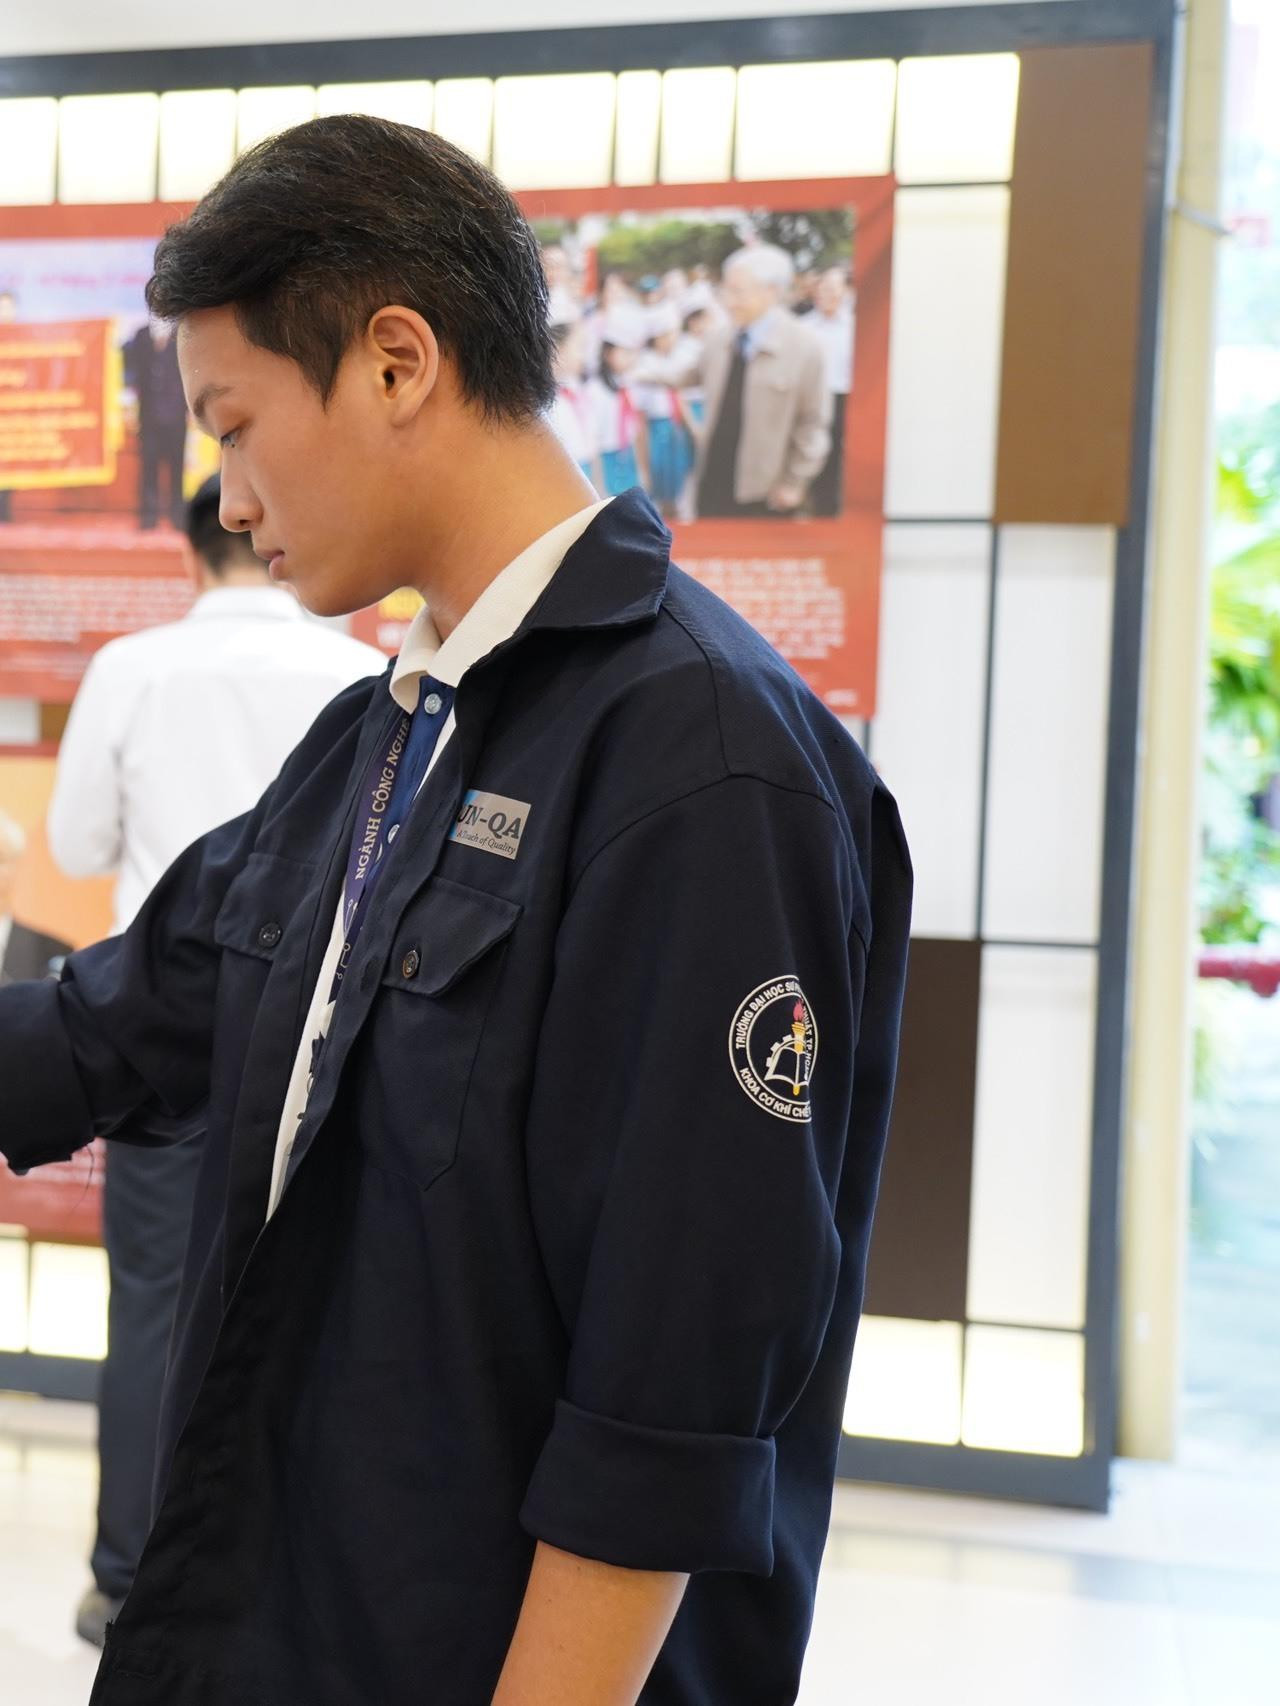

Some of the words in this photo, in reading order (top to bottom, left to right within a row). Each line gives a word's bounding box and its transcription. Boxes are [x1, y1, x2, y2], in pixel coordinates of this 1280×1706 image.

[355, 818, 381, 881] NGÀNH
[371, 767, 395, 812] CÔNG
[735, 1010, 754, 1050] TRƯỜNG
[749, 995, 766, 1013] ĐẠI
[765, 983, 786, 999] HỌC
[739, 1067, 759, 1096] KHOA
[758, 1091, 775, 1108] CƠ
[773, 1100, 792, 1116] KHÍ
